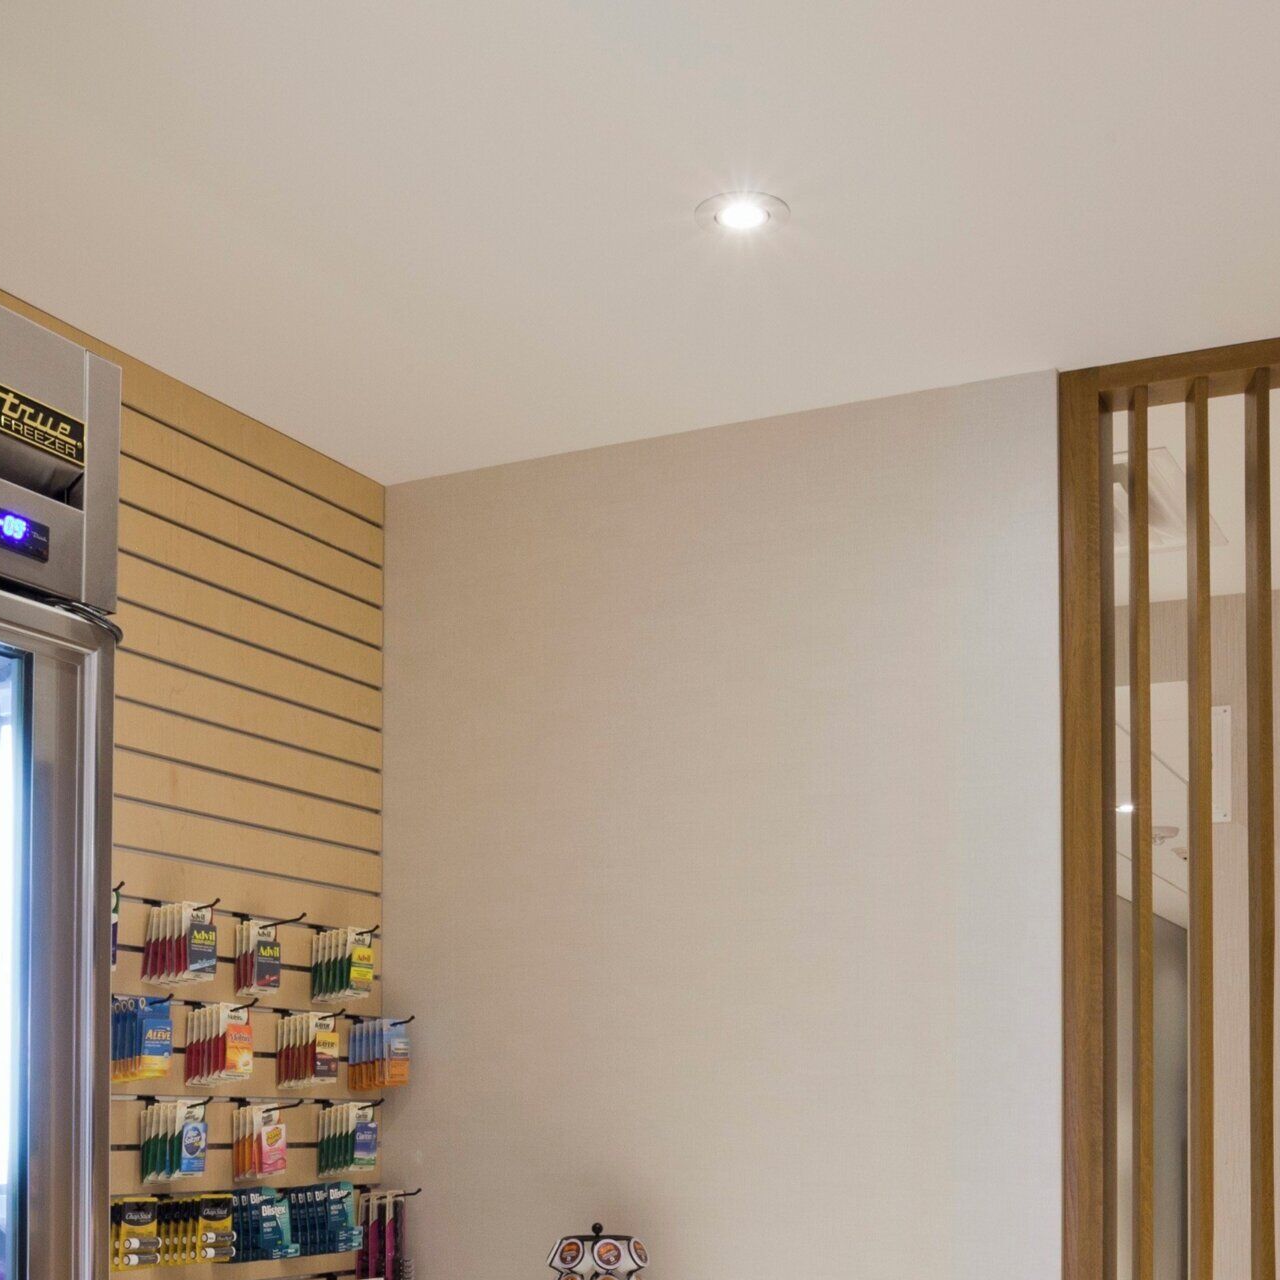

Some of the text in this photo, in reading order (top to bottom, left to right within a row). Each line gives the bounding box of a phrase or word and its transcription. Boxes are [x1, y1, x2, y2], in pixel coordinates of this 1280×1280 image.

[1, 415, 76, 457] FREEZER
[193, 929, 216, 941] Advil
[260, 946, 280, 958] Advil
[145, 1028, 172, 1041] ALEVE
[125, 1211, 153, 1222] ChapStick
[261, 1203, 287, 1218] Blistex
